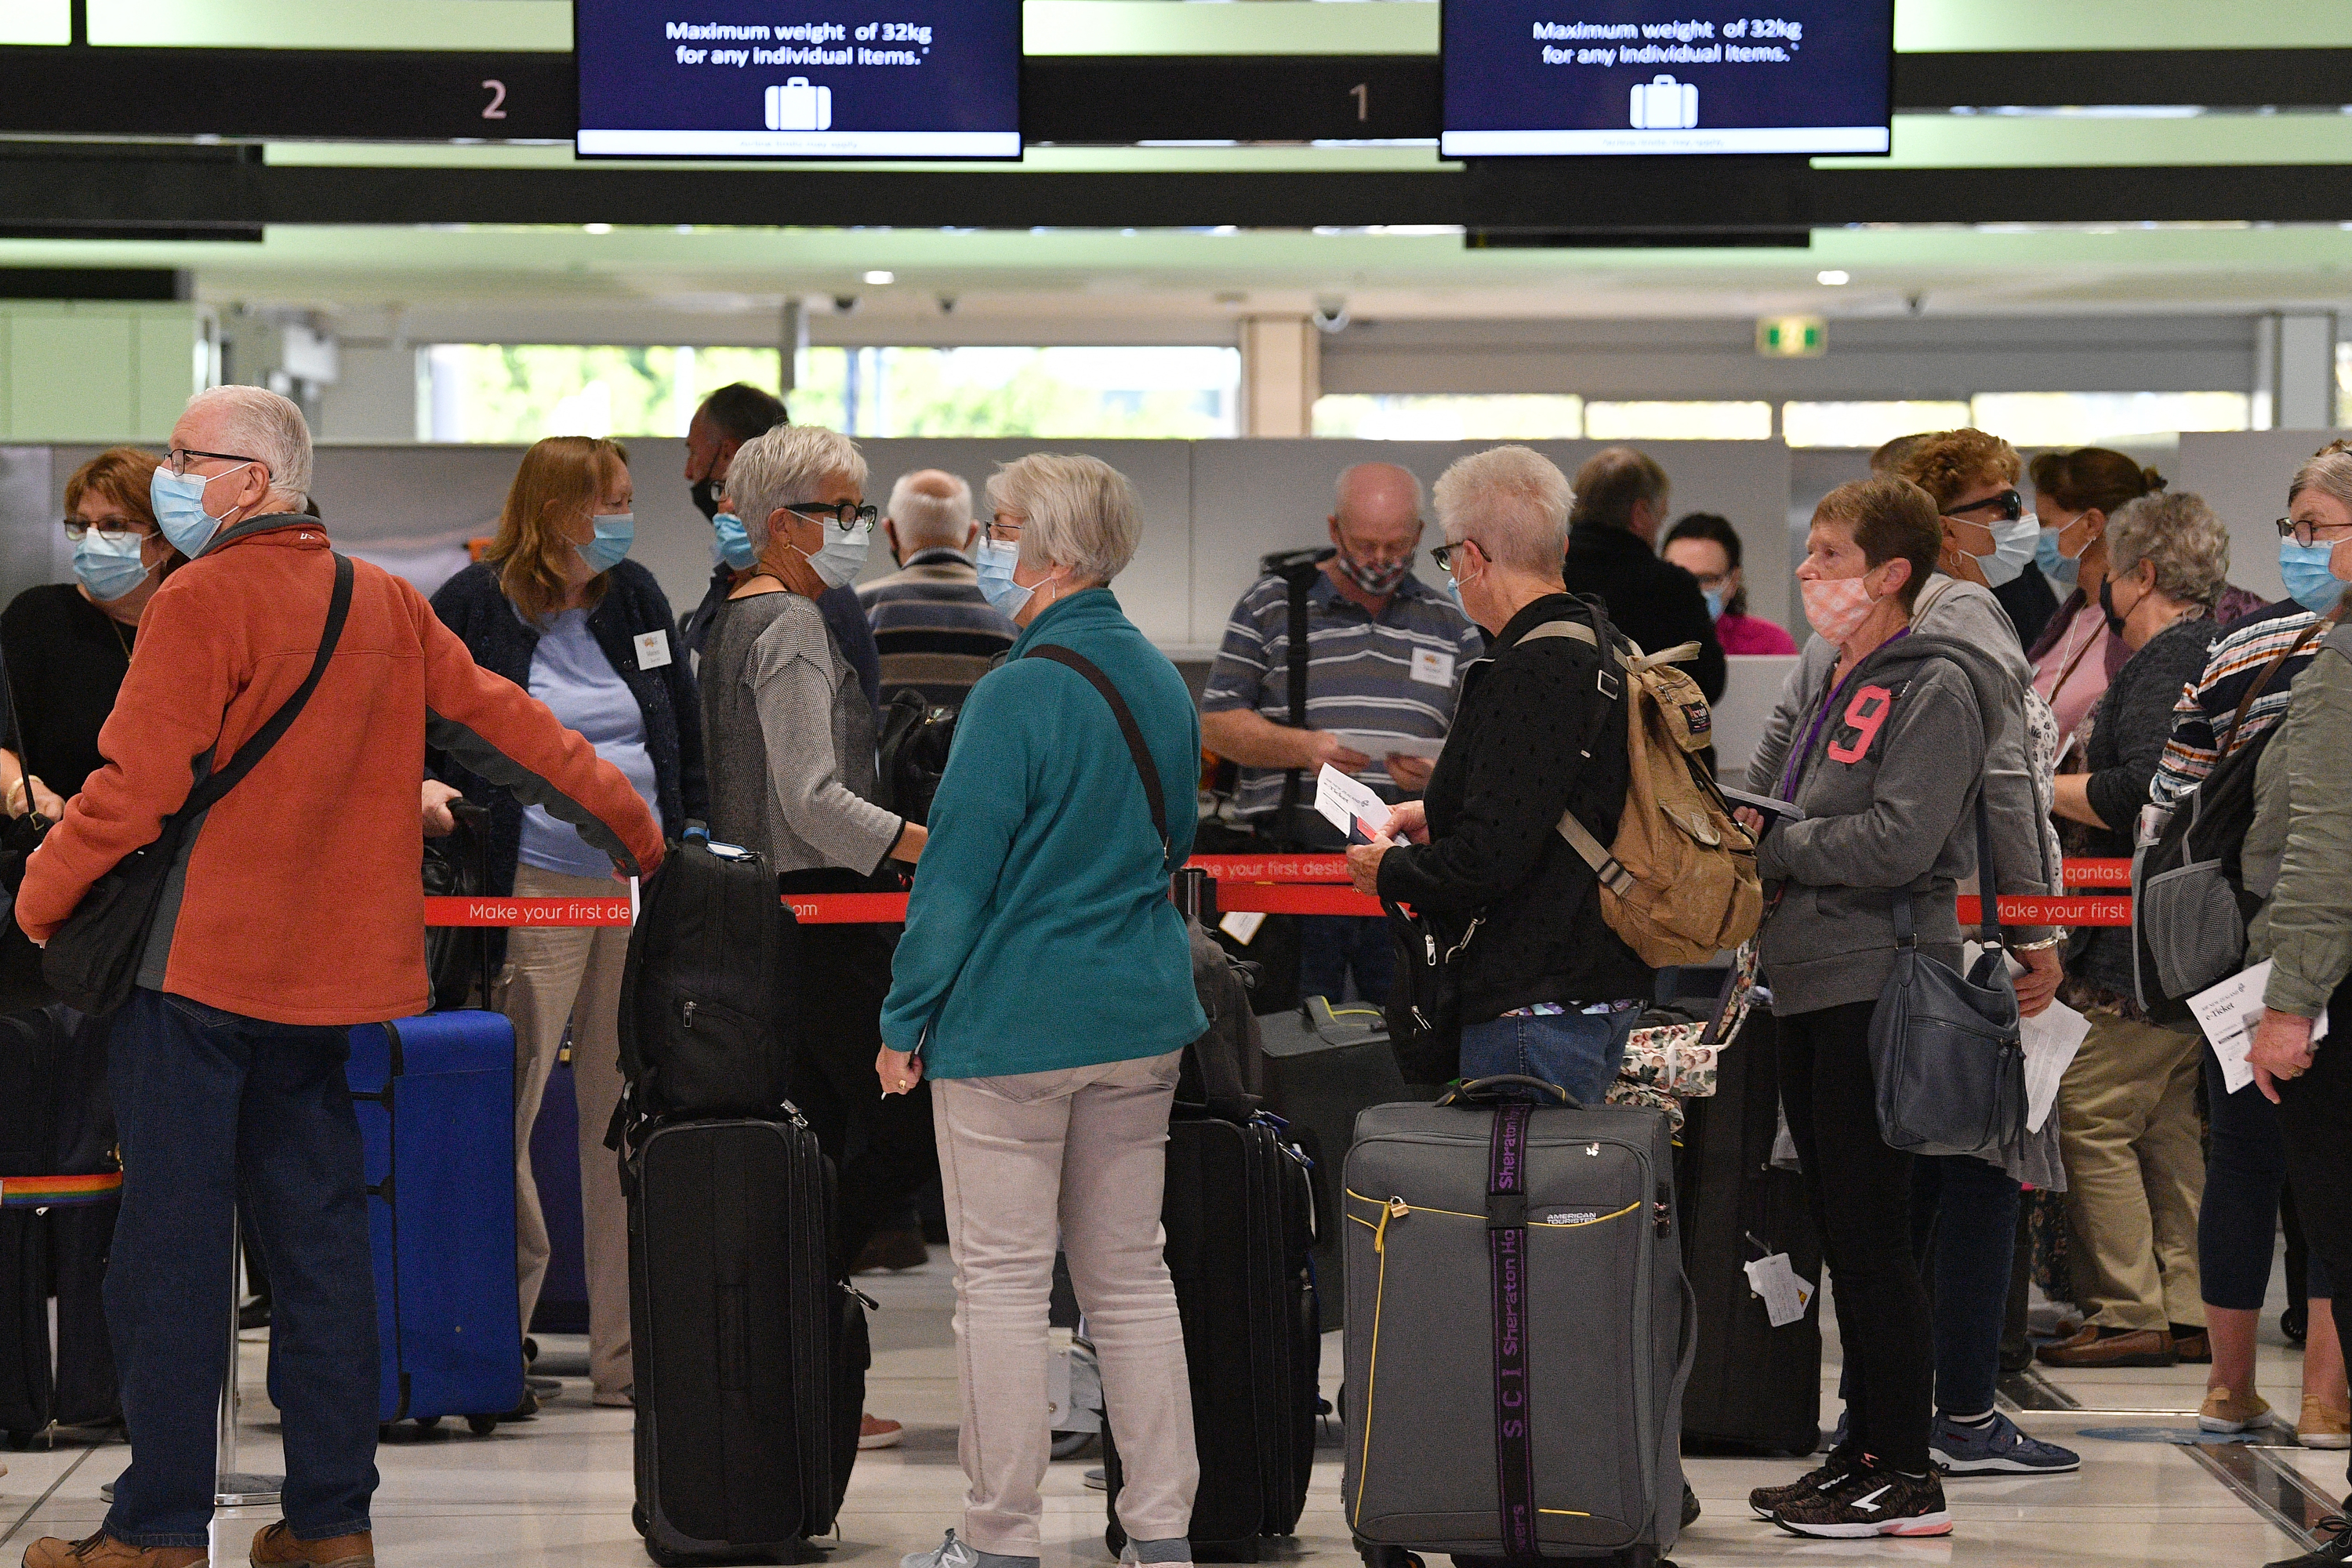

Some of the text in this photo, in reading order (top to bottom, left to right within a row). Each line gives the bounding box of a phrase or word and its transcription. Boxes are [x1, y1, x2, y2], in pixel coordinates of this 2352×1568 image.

[666, 22, 933, 45] Maximum weight of 32kg
[1533, 18, 1803, 42] Maximum weight of 32kg
[675, 45, 707, 64] for
[710, 49, 750, 68] any
[753, 46, 853, 65] individual
[1541, 45, 1575, 64] for
[1577, 47, 1617, 67] any
[1619, 43, 1722, 64] individual
[481, 79, 507, 119] 2
[1349, 83, 1368, 122] 1
[1828, 685, 1892, 764] 9
[1228, 863, 1262, 879] your
[1267, 861, 1298, 877] first
[470, 903, 630, 923] Make your first de
[2044, 905, 2085, 922] your
[2092, 902, 2125, 919] first
[2205, 1002, 2234, 1021] e-Ticket
[1499, 1122, 1517, 1189] Sheraton
[1501, 1229, 1516, 1254] Ho
[1503, 1258, 1519, 1356] Sheraton
